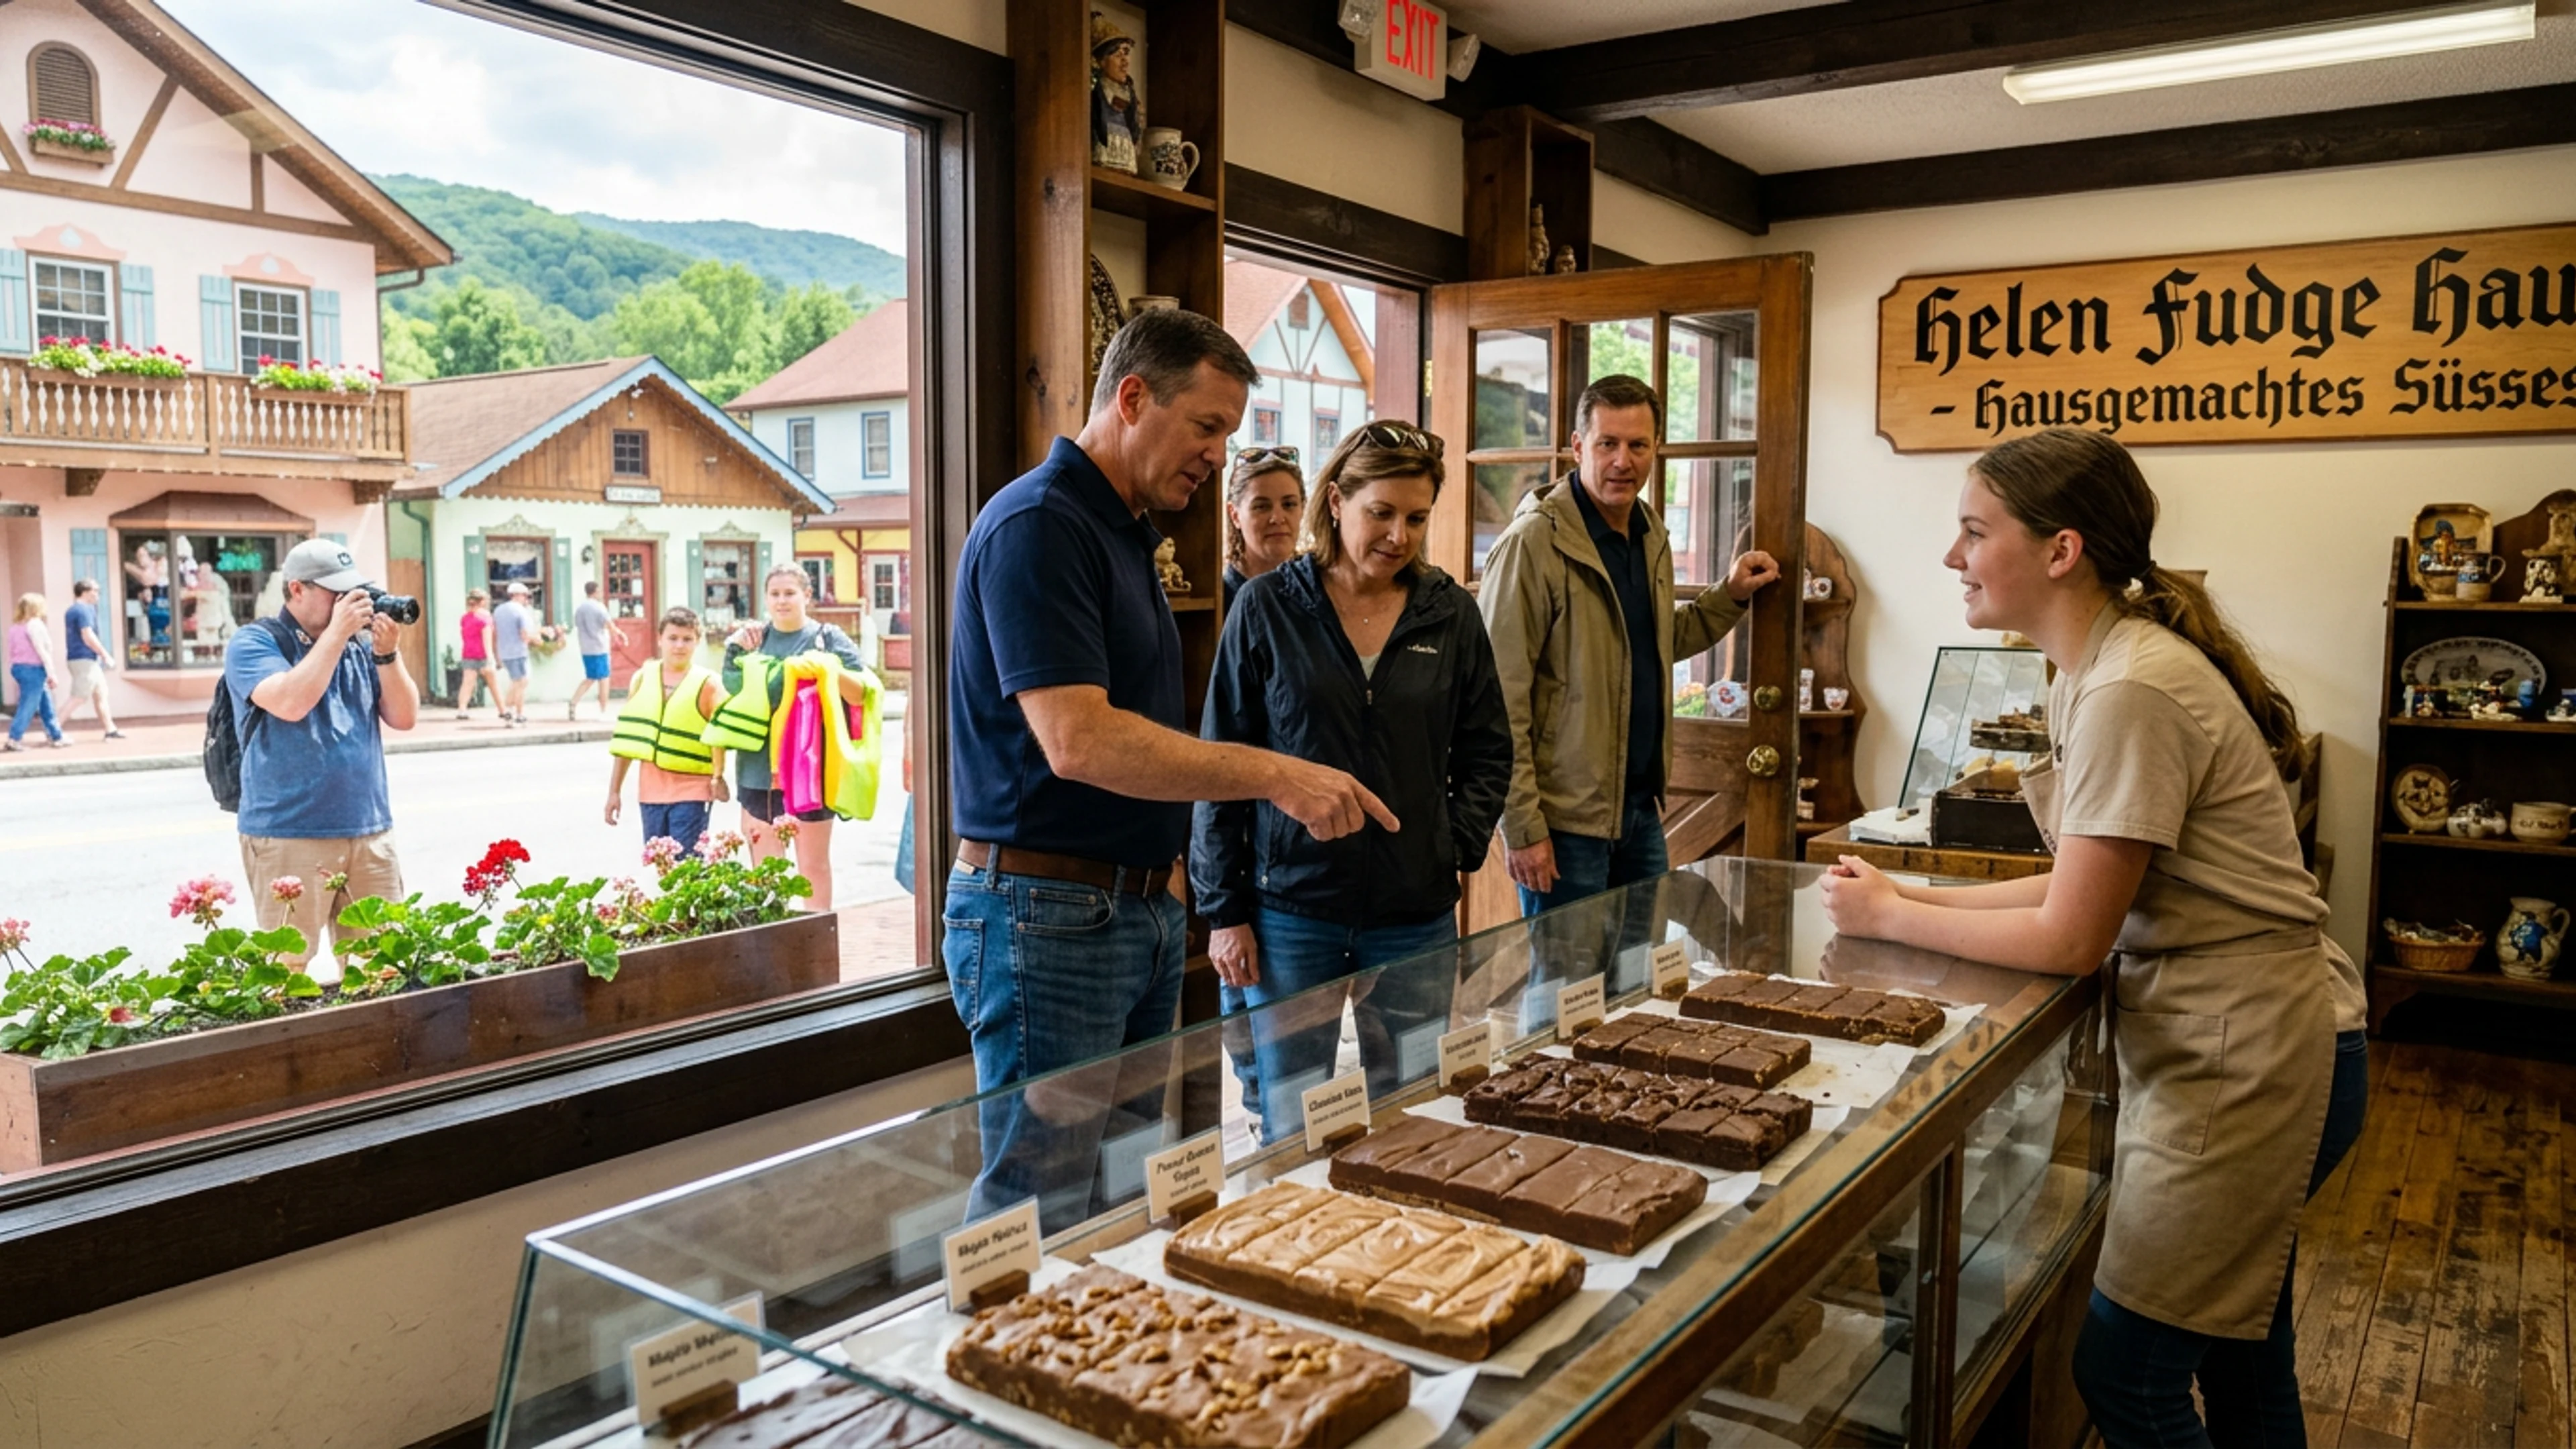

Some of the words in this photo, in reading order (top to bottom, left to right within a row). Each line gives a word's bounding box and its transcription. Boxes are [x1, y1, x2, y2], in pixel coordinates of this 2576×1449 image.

[1386, 0, 1440, 80] EXIT
[1915, 282, 2112, 376] Helen
[2136, 263, 2381, 365] Fudge
[1975, 366, 2364, 437] Hausgemachtes
